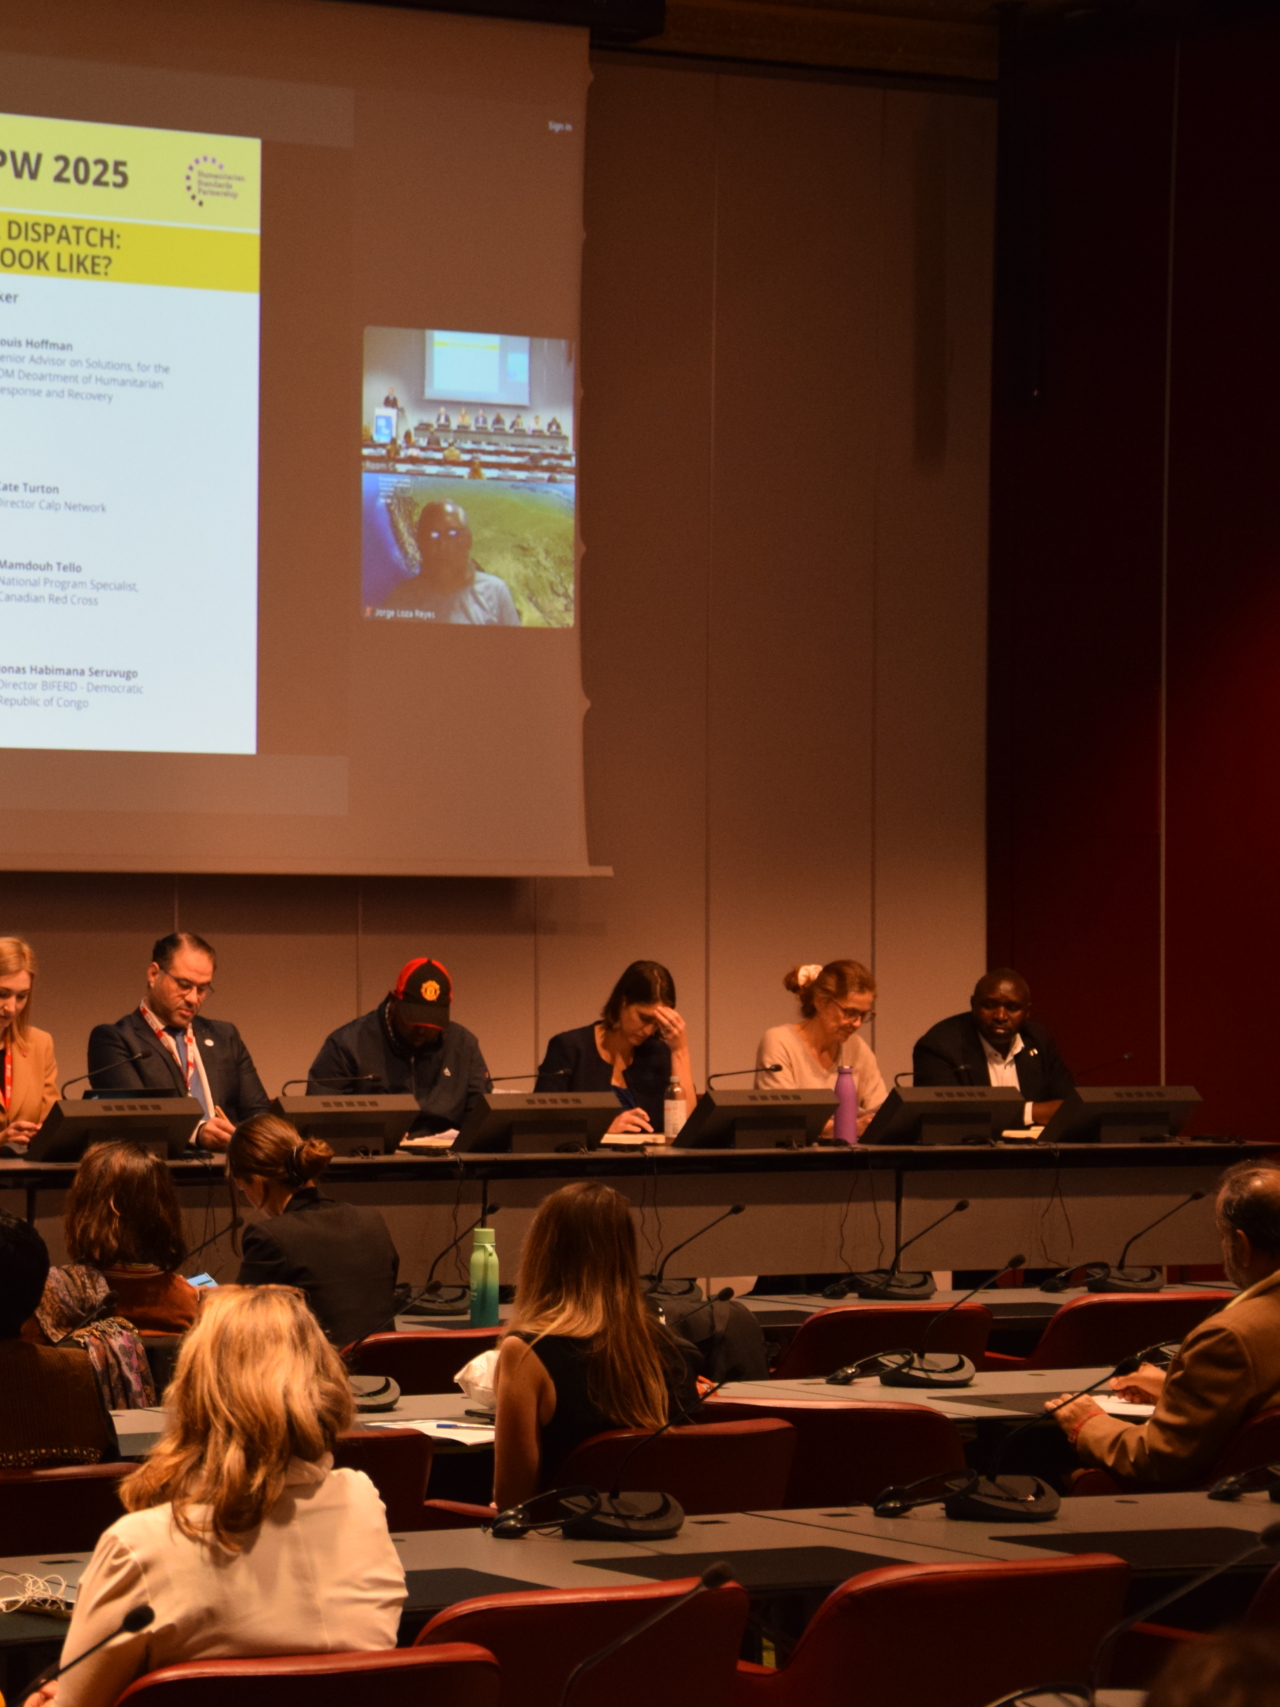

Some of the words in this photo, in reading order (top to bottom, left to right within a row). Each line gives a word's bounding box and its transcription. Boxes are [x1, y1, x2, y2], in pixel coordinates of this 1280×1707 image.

[53, 155, 129, 189] 2025
[7, 220, 121, 250] DISPATCH:
[56, 253, 112, 276] LIKE?
[26, 339, 73, 351] Hoffman
[29, 355, 66, 367] Advisor
[70, 358, 82, 367] on
[86, 358, 134, 372] Solutions,
[137, 361, 150, 372] for
[154, 364, 170, 374] the
[82, 374, 92, 384] of
[95, 376, 163, 389] Humanitarian
[46, 387, 64, 399] and
[68, 389, 113, 404] Recovery
[23, 482, 59, 495] Turton
[39, 499, 61, 513] Calp
[64, 501, 107, 513] Network
[56, 561, 82, 573] Tello
[43, 578, 88, 591] Program
[49, 593, 68, 605] Red
[70, 594, 99, 606] Cross
[375, 609, 394, 620] Jorge
[397, 609, 413, 618] Loza
[30, 665, 85, 677] Habimana
[88, 667, 138, 680] Seruvugo
[41, 681, 78, 693] BIFERD
[86, 682, 144, 695] Democratic
[44, 696, 54, 707] of
[56, 698, 89, 711] Congo
